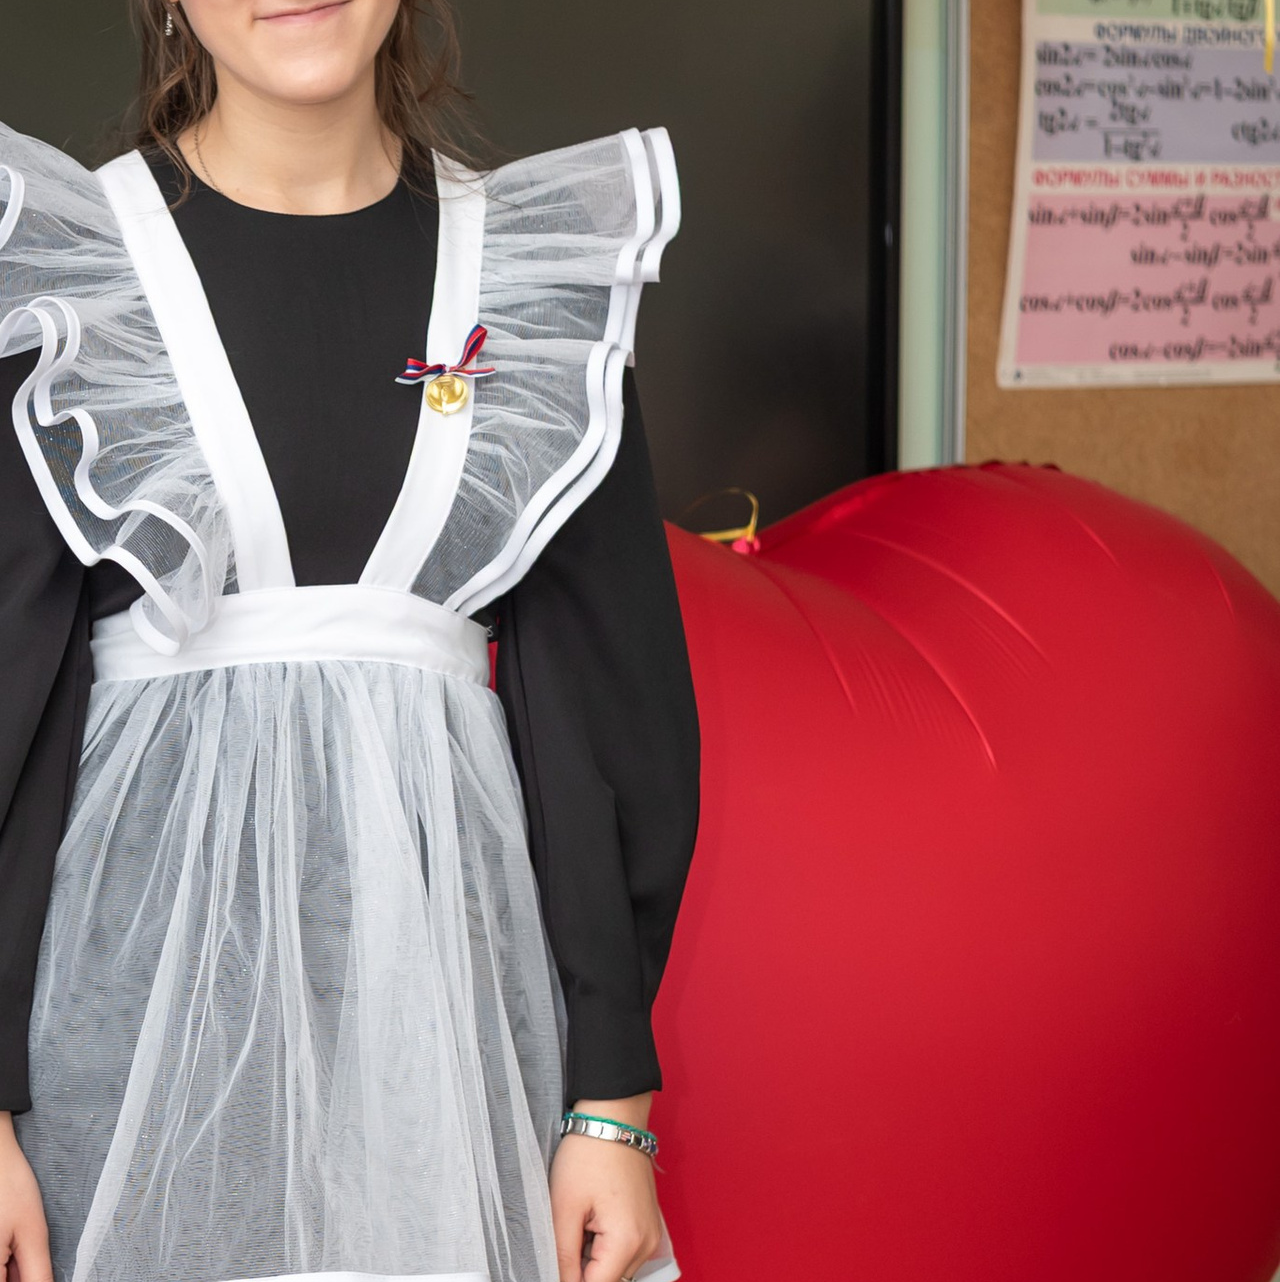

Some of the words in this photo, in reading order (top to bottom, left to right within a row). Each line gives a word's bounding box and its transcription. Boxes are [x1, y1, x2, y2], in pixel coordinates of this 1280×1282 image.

[1095, 24, 1176, 43] ФОРМУЛЫ
[1183, 26, 1273, 47] ДВОЙНОГ
[1033, 168, 1120, 188] ФОРМУЛЫ
